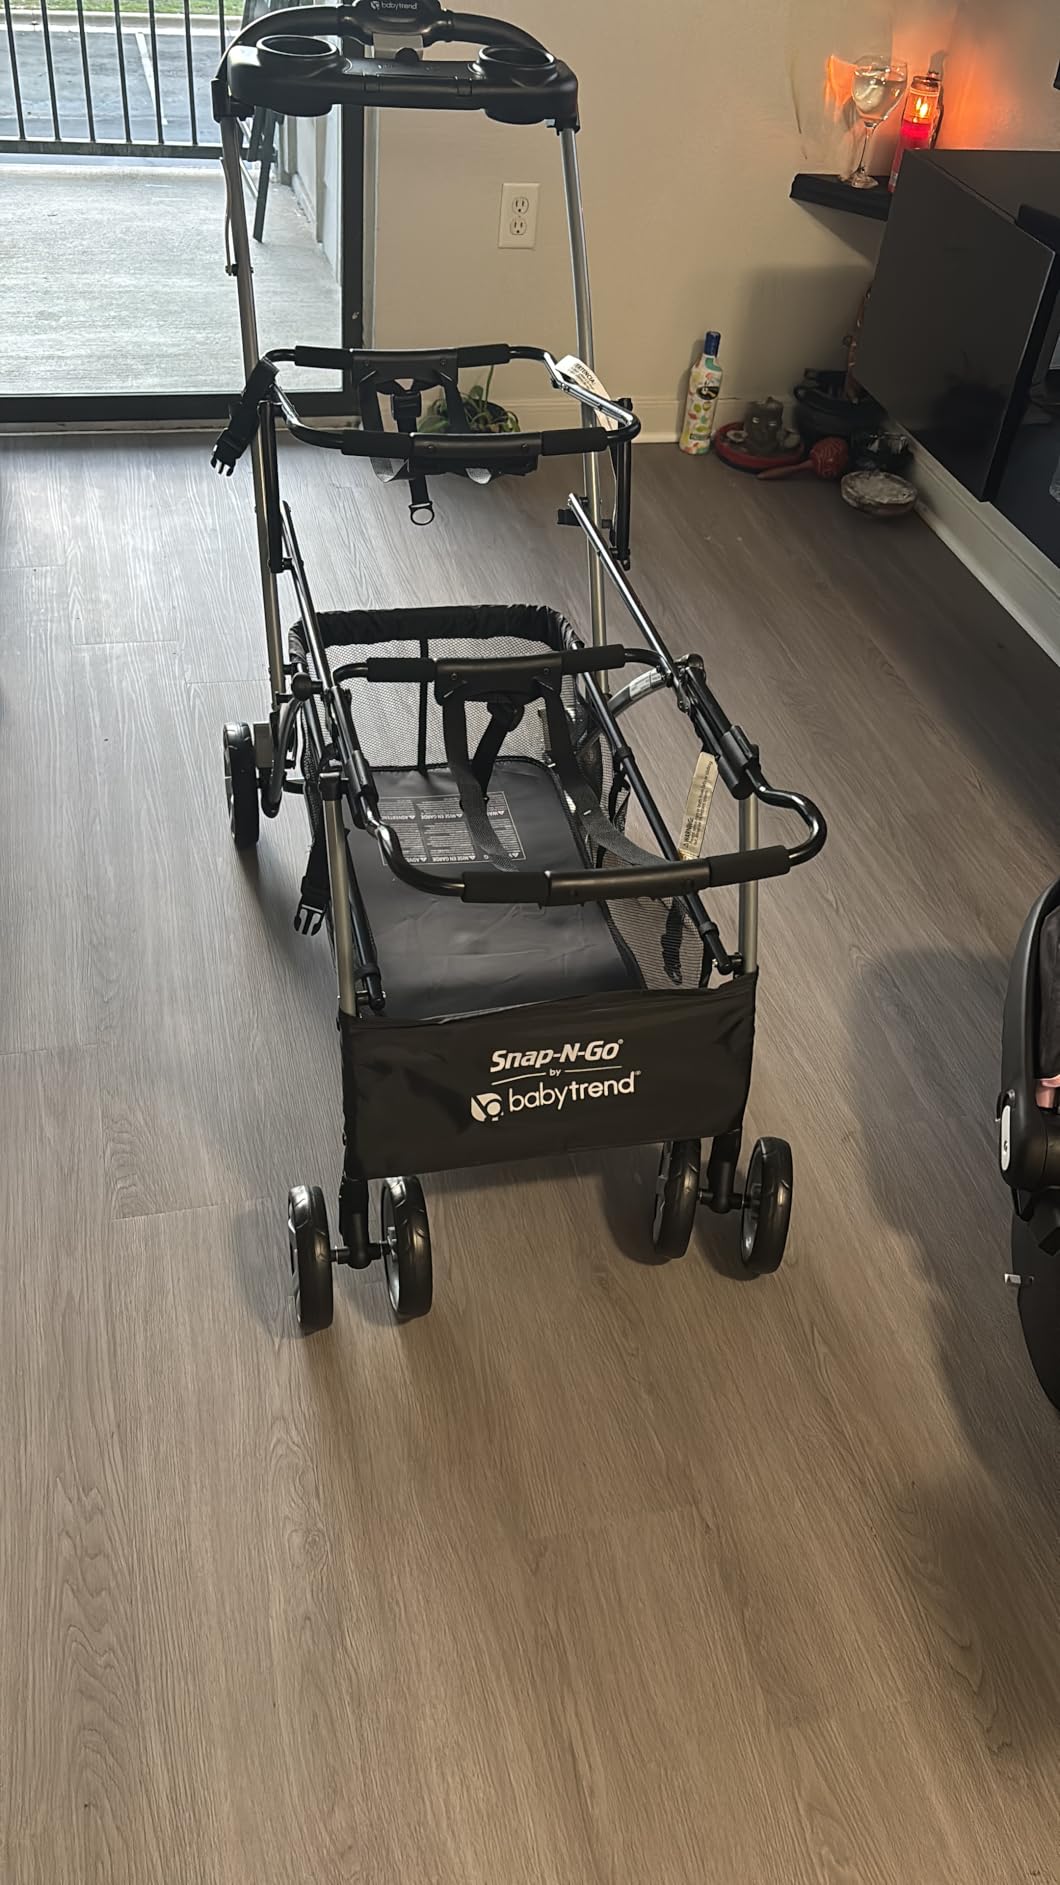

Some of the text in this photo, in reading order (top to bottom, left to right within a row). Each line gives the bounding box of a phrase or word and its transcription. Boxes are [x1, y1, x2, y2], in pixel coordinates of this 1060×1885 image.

[381, 2, 418, 11] babytrend
[549, 1068, 562, 1077] by
[508, 1071, 635, 1111] babytrend
